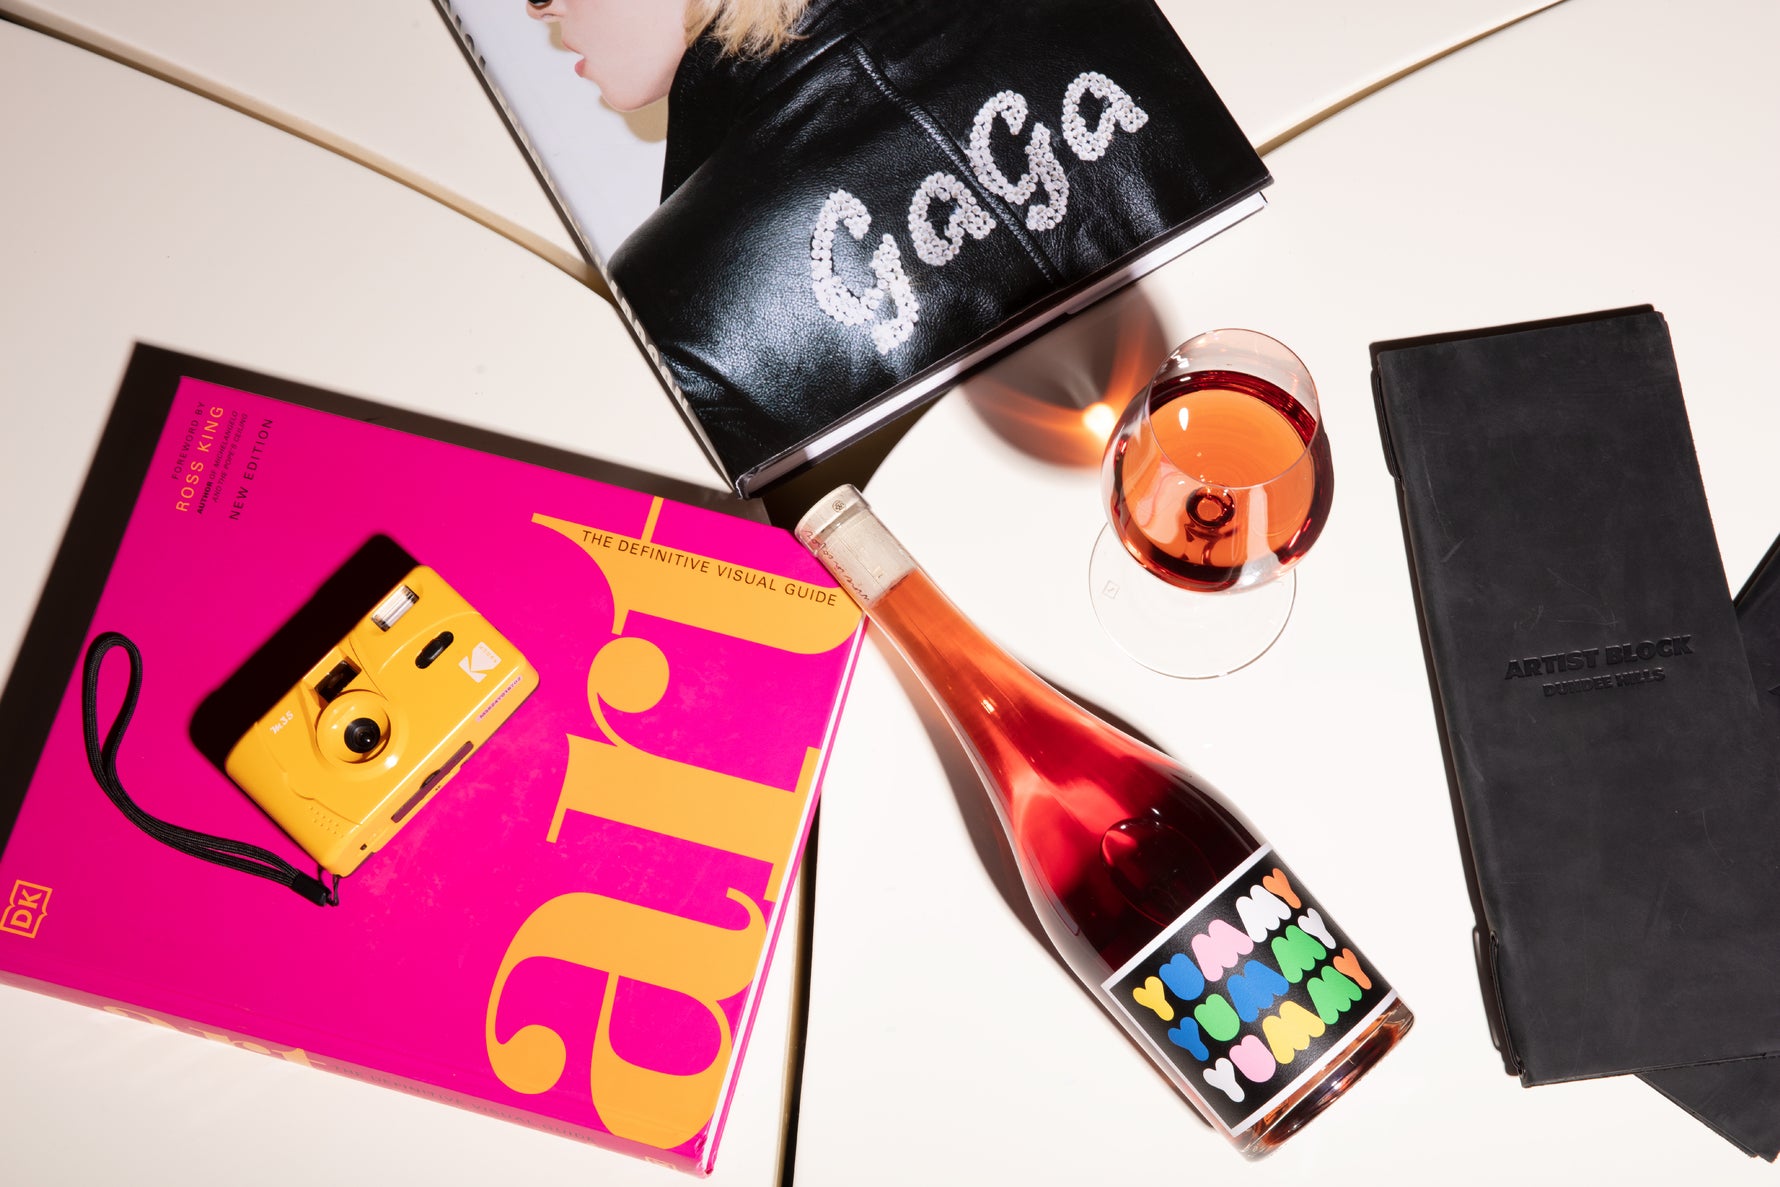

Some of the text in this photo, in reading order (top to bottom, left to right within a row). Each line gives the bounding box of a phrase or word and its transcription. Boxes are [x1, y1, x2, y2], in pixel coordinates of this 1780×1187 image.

[172, 402, 205, 480] FOREWORD BY
[176, 406, 223, 512] ROSS KING
[197, 481, 213, 514] AUTHOR
[214, 410, 238, 468] MICHELANGELO
[229, 419, 272, 520] NEW EDITION
[582, 530, 838, 606] THE DEFINITIVE VISUAL GUIDE
[1504, 634, 1693, 680] ARTIST BLOCK
[1542, 667, 1666, 697] DUNDEE HILLS
[486, 497, 863, 1150] art
[10, 888, 42, 929] DK
[1133, 868, 1301, 1021] YUMMY
[1168, 907, 1336, 1061] YUMMY
[1203, 948, 1372, 1102] YUMMY
